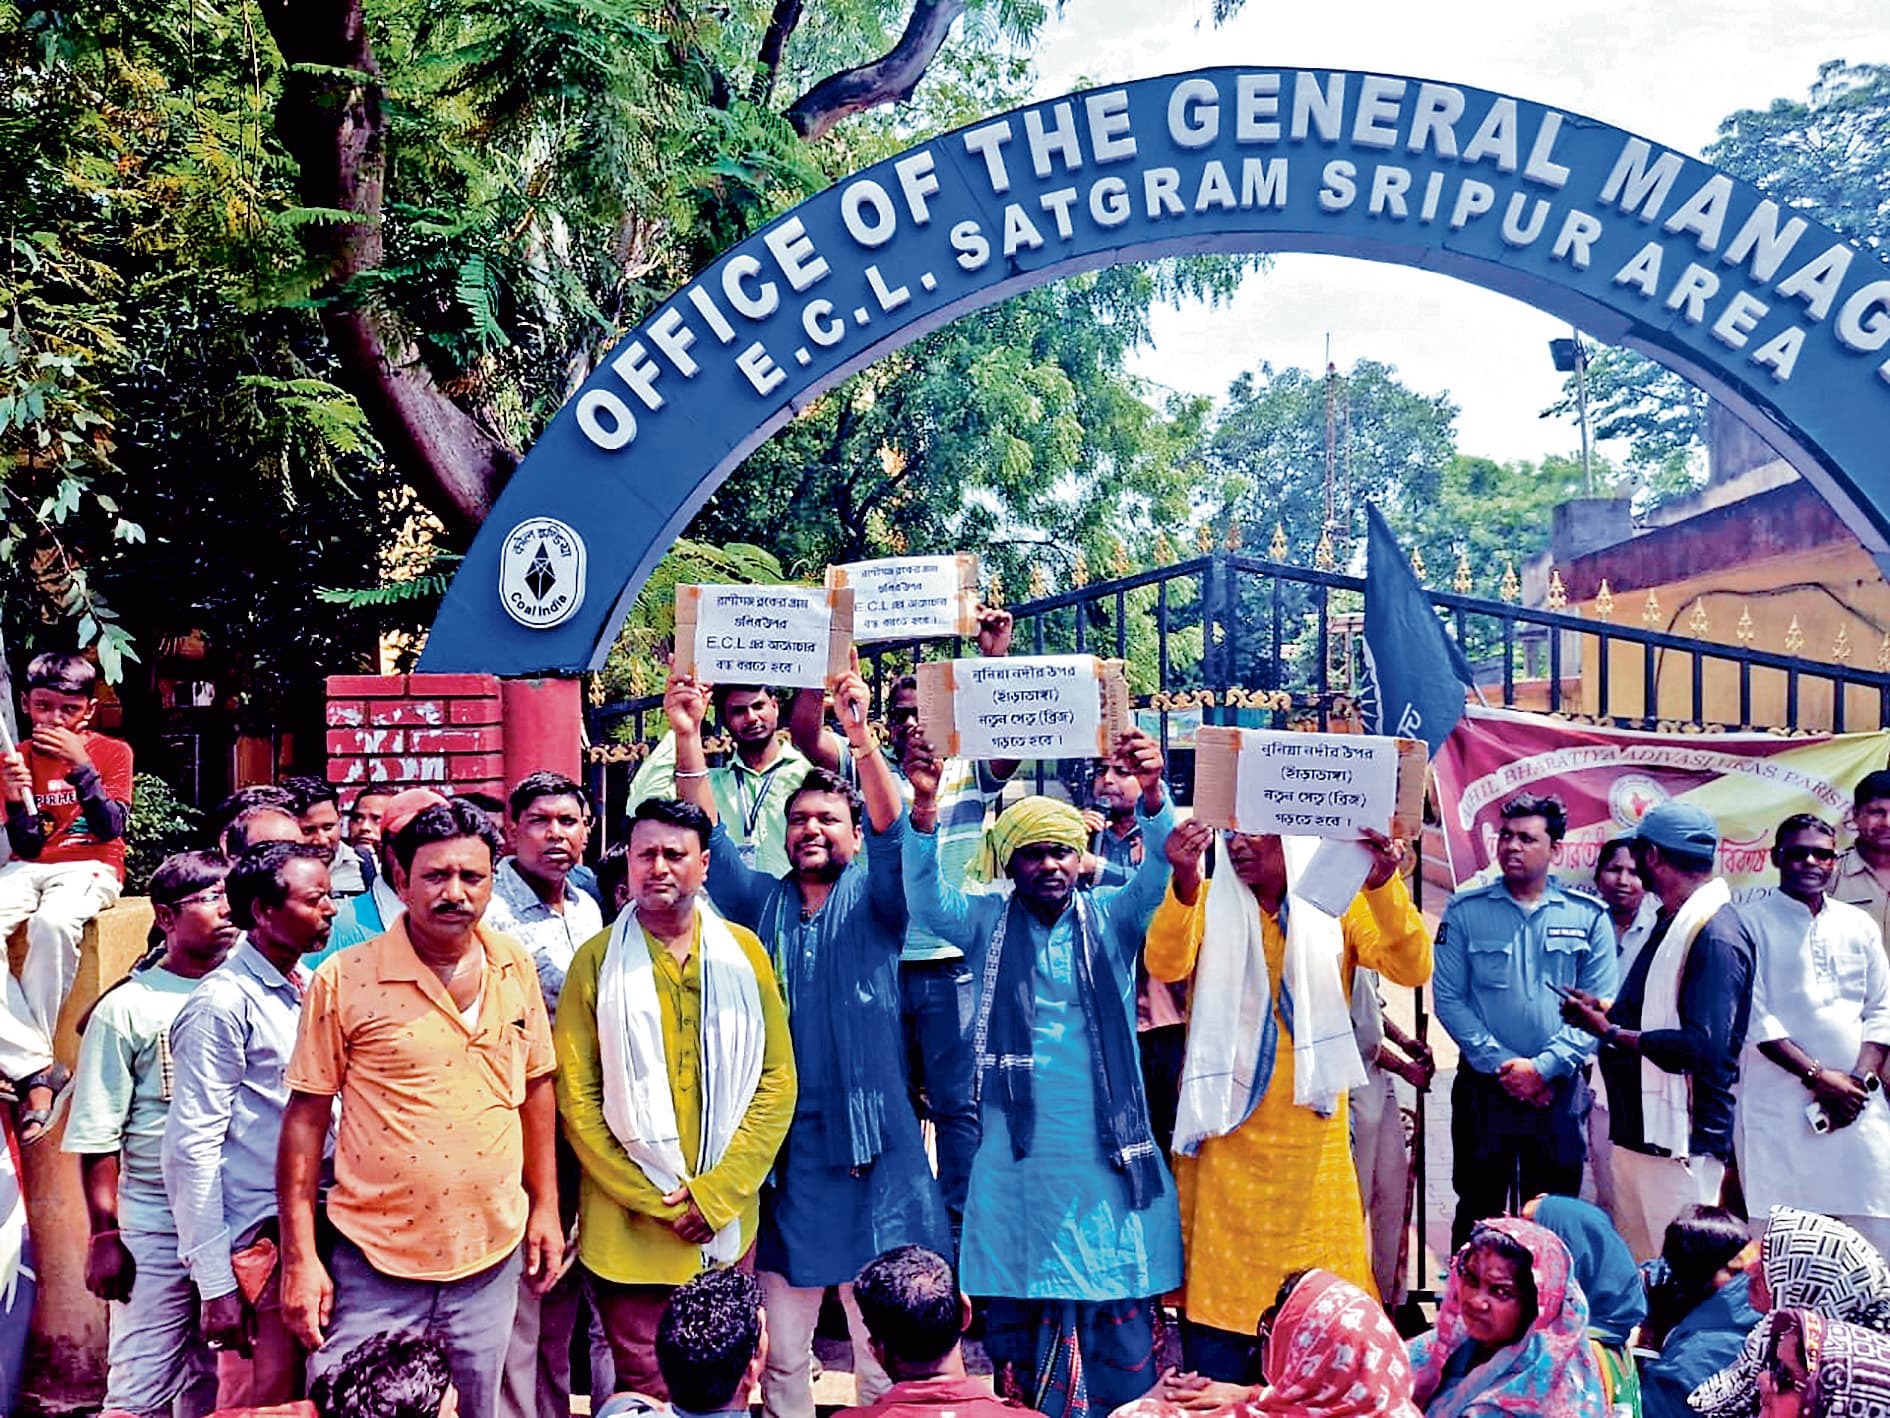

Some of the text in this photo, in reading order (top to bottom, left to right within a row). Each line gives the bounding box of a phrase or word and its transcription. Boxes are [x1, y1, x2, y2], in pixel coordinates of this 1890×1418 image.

[576, 72, 1890, 449] OFFICE OF THE GENERAL MANAG
[950, 158, 1289, 271] SATGRAM
[1319, 160, 1602, 270] SRIPUR
[1614, 241, 1806, 383] AREA
[511, 592, 567, 616] Coal India
